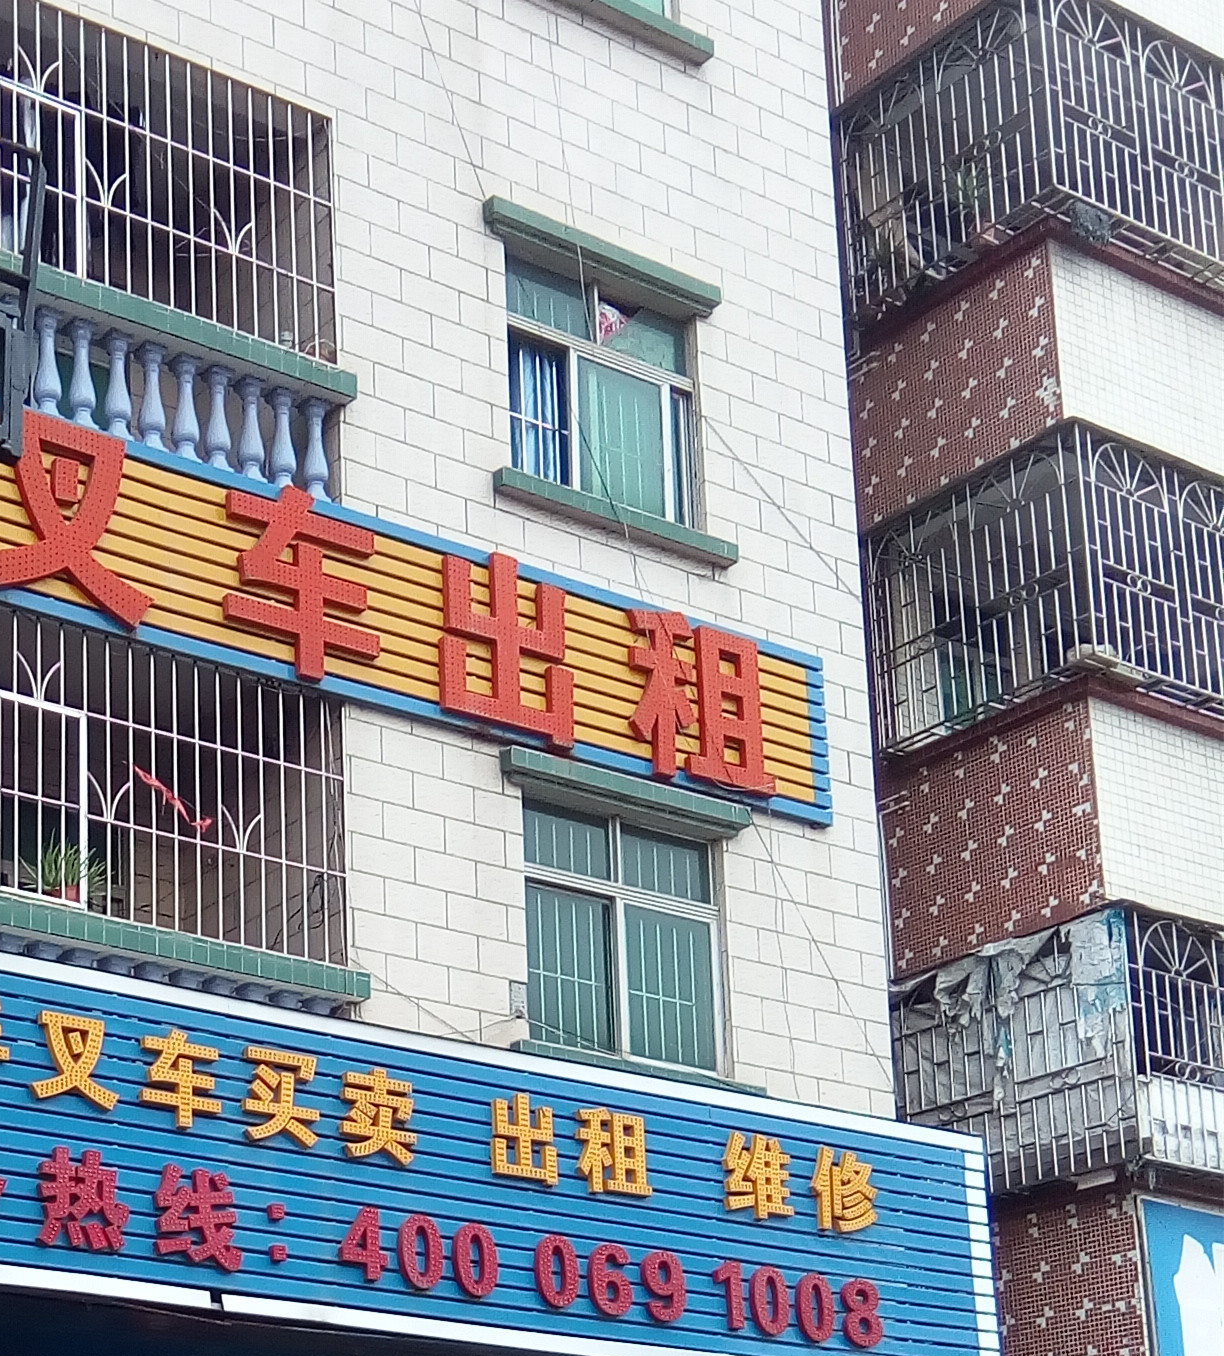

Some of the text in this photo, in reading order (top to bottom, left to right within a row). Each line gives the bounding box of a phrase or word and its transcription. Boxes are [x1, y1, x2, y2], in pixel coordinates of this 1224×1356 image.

[489, 1091, 653, 1197] 出租
[722, 1130, 879, 1234] 维修
[338, 1205, 500, 1298] 400
[534, 1234, 687, 1323] 069
[712, 1259, 883, 1349] 1008
